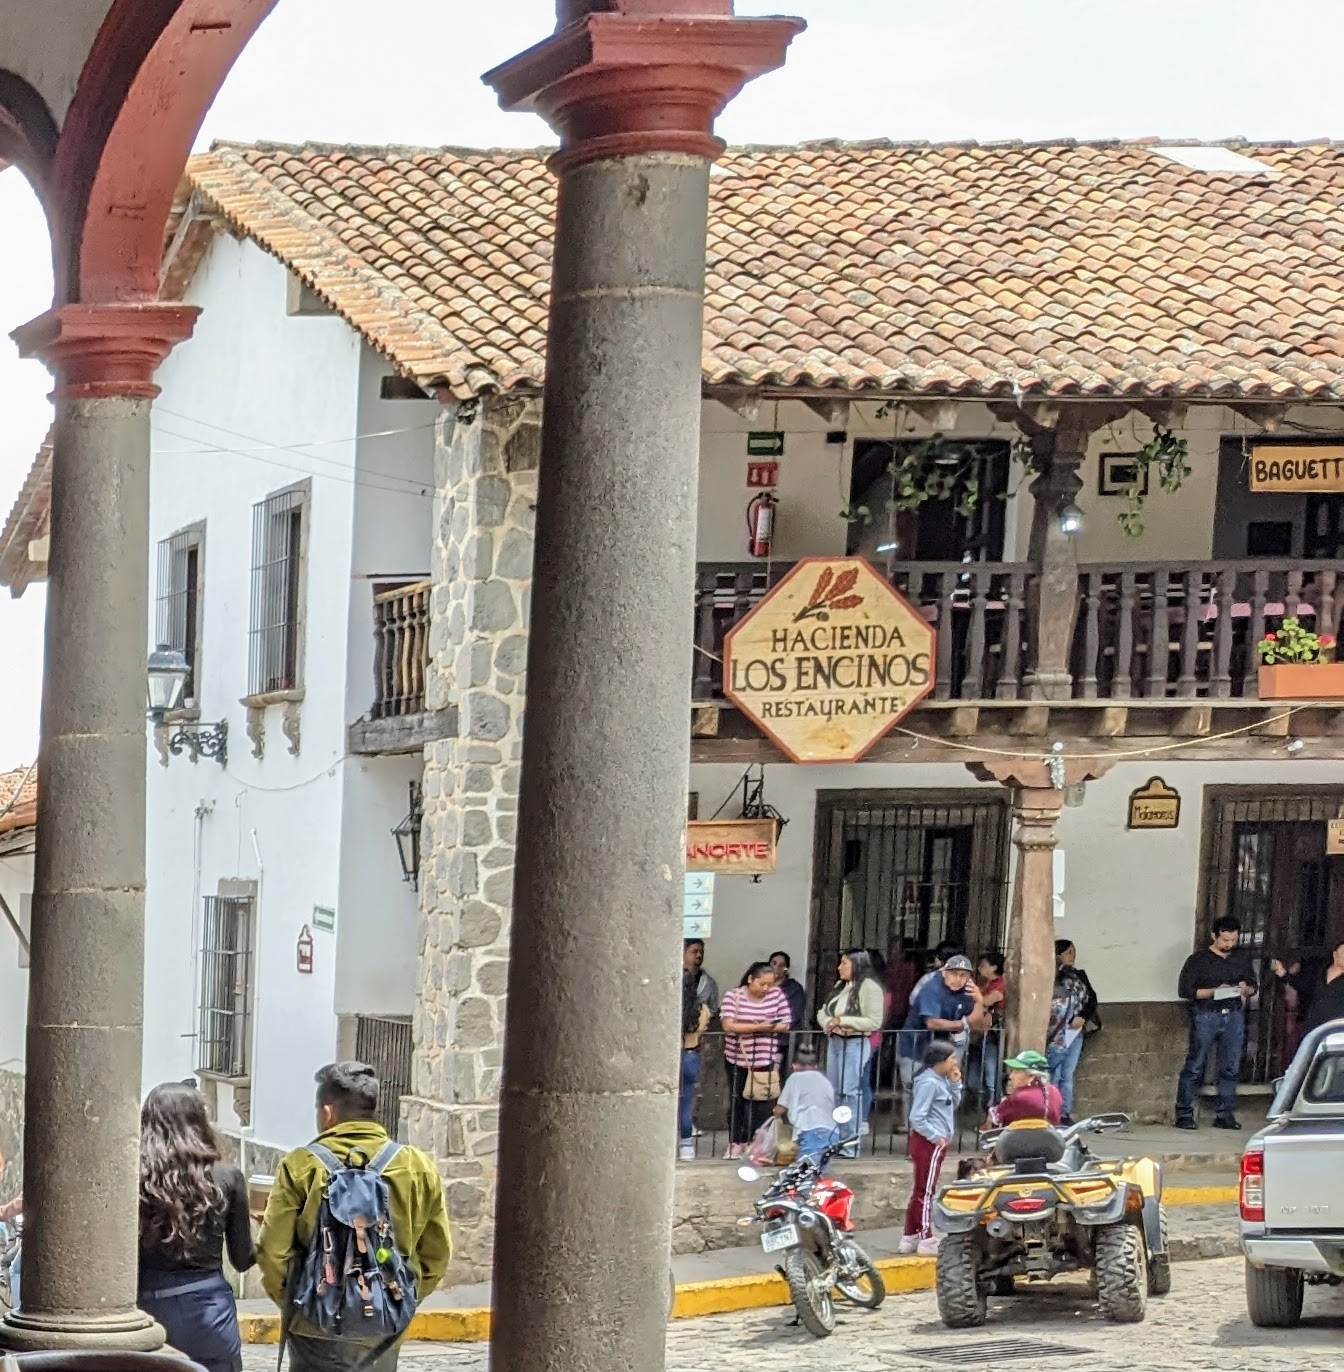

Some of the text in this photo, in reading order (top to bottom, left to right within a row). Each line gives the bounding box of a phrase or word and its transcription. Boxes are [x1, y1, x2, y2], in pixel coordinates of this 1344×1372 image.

[771, 624, 906, 652] HACIENDA
[732, 653, 930, 692] LOS ENCINOS
[762, 696, 899, 721] RESTAURANTE
